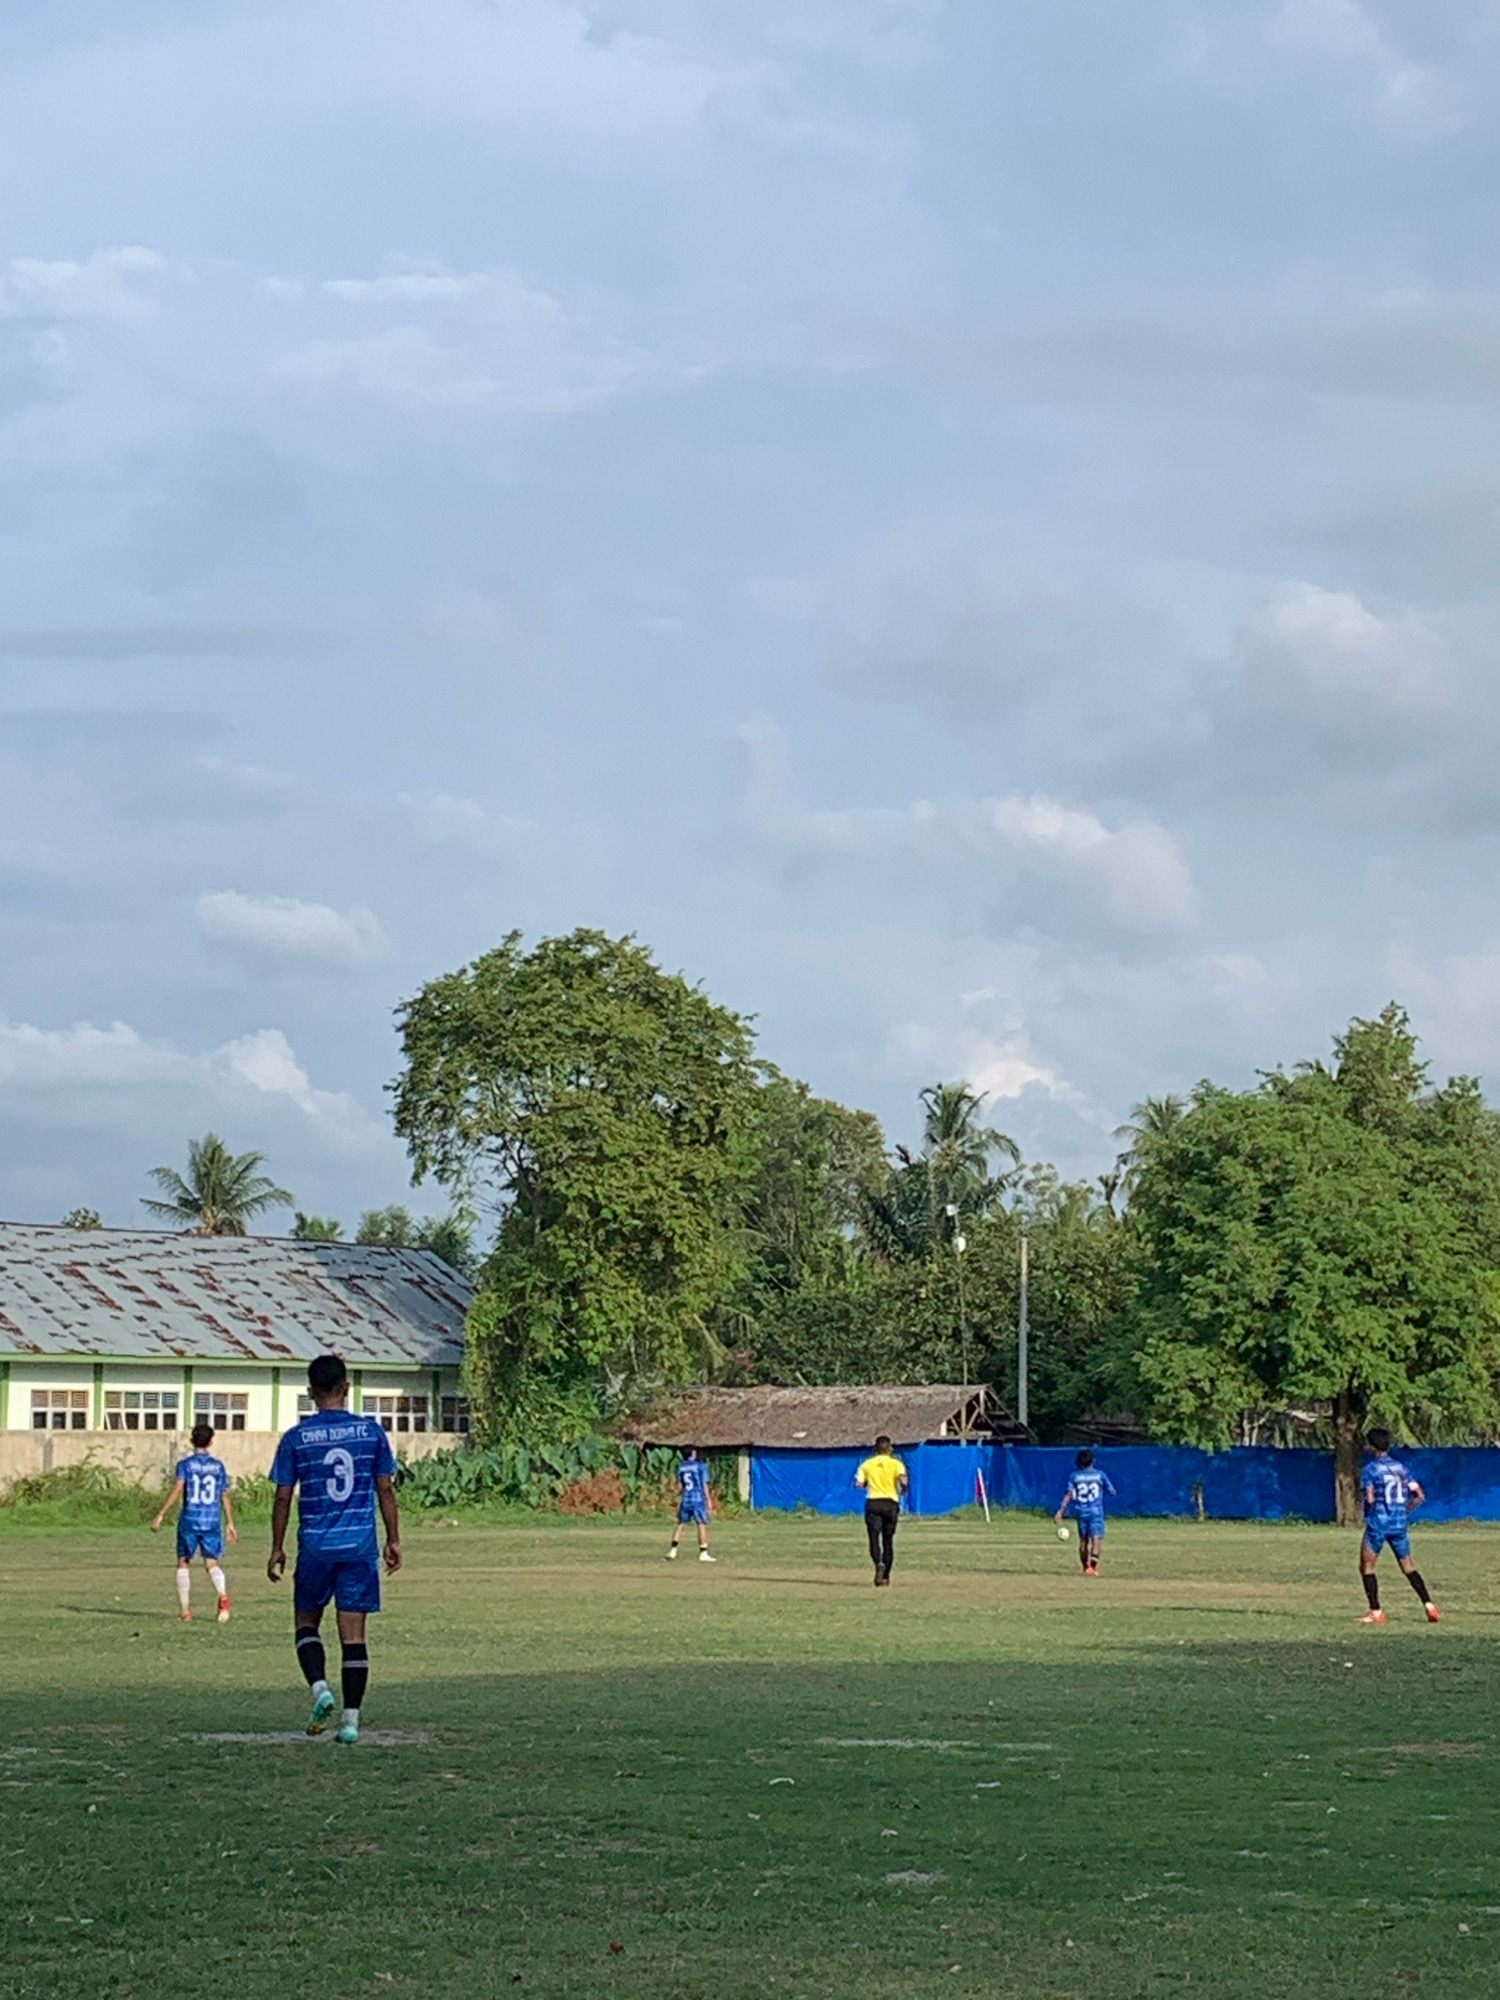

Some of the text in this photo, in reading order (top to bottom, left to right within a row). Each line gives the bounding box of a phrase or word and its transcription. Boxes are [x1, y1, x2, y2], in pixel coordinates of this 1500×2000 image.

[190, 1473, 216, 1505] 13
[323, 1447, 354, 1502] 3
[683, 1472, 694, 1491] 5
[1383, 1474, 1405, 1504] 71
[1077, 1482, 1100, 1503] 23
